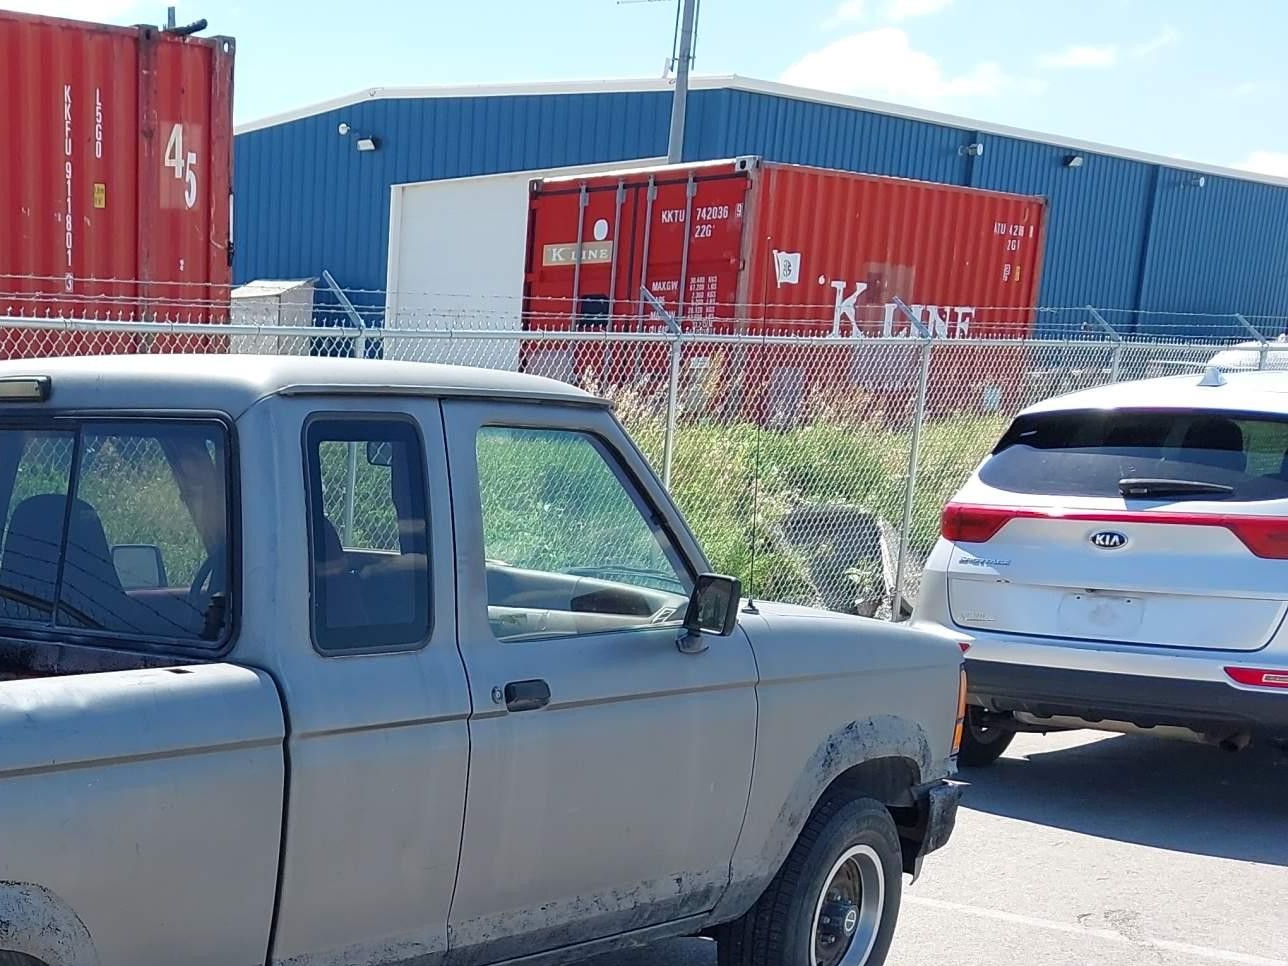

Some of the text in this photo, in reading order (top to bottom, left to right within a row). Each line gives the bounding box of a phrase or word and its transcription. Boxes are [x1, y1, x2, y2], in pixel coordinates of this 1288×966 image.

[64, 84, 72, 155] KKFU
[164, 123, 197, 209] 45
[65, 161, 73, 266] 911801
[661, 202, 743, 224] KKTU 742036 9
[571, 248, 609, 261] LINE
[1095, 534, 1121, 546] KIA
